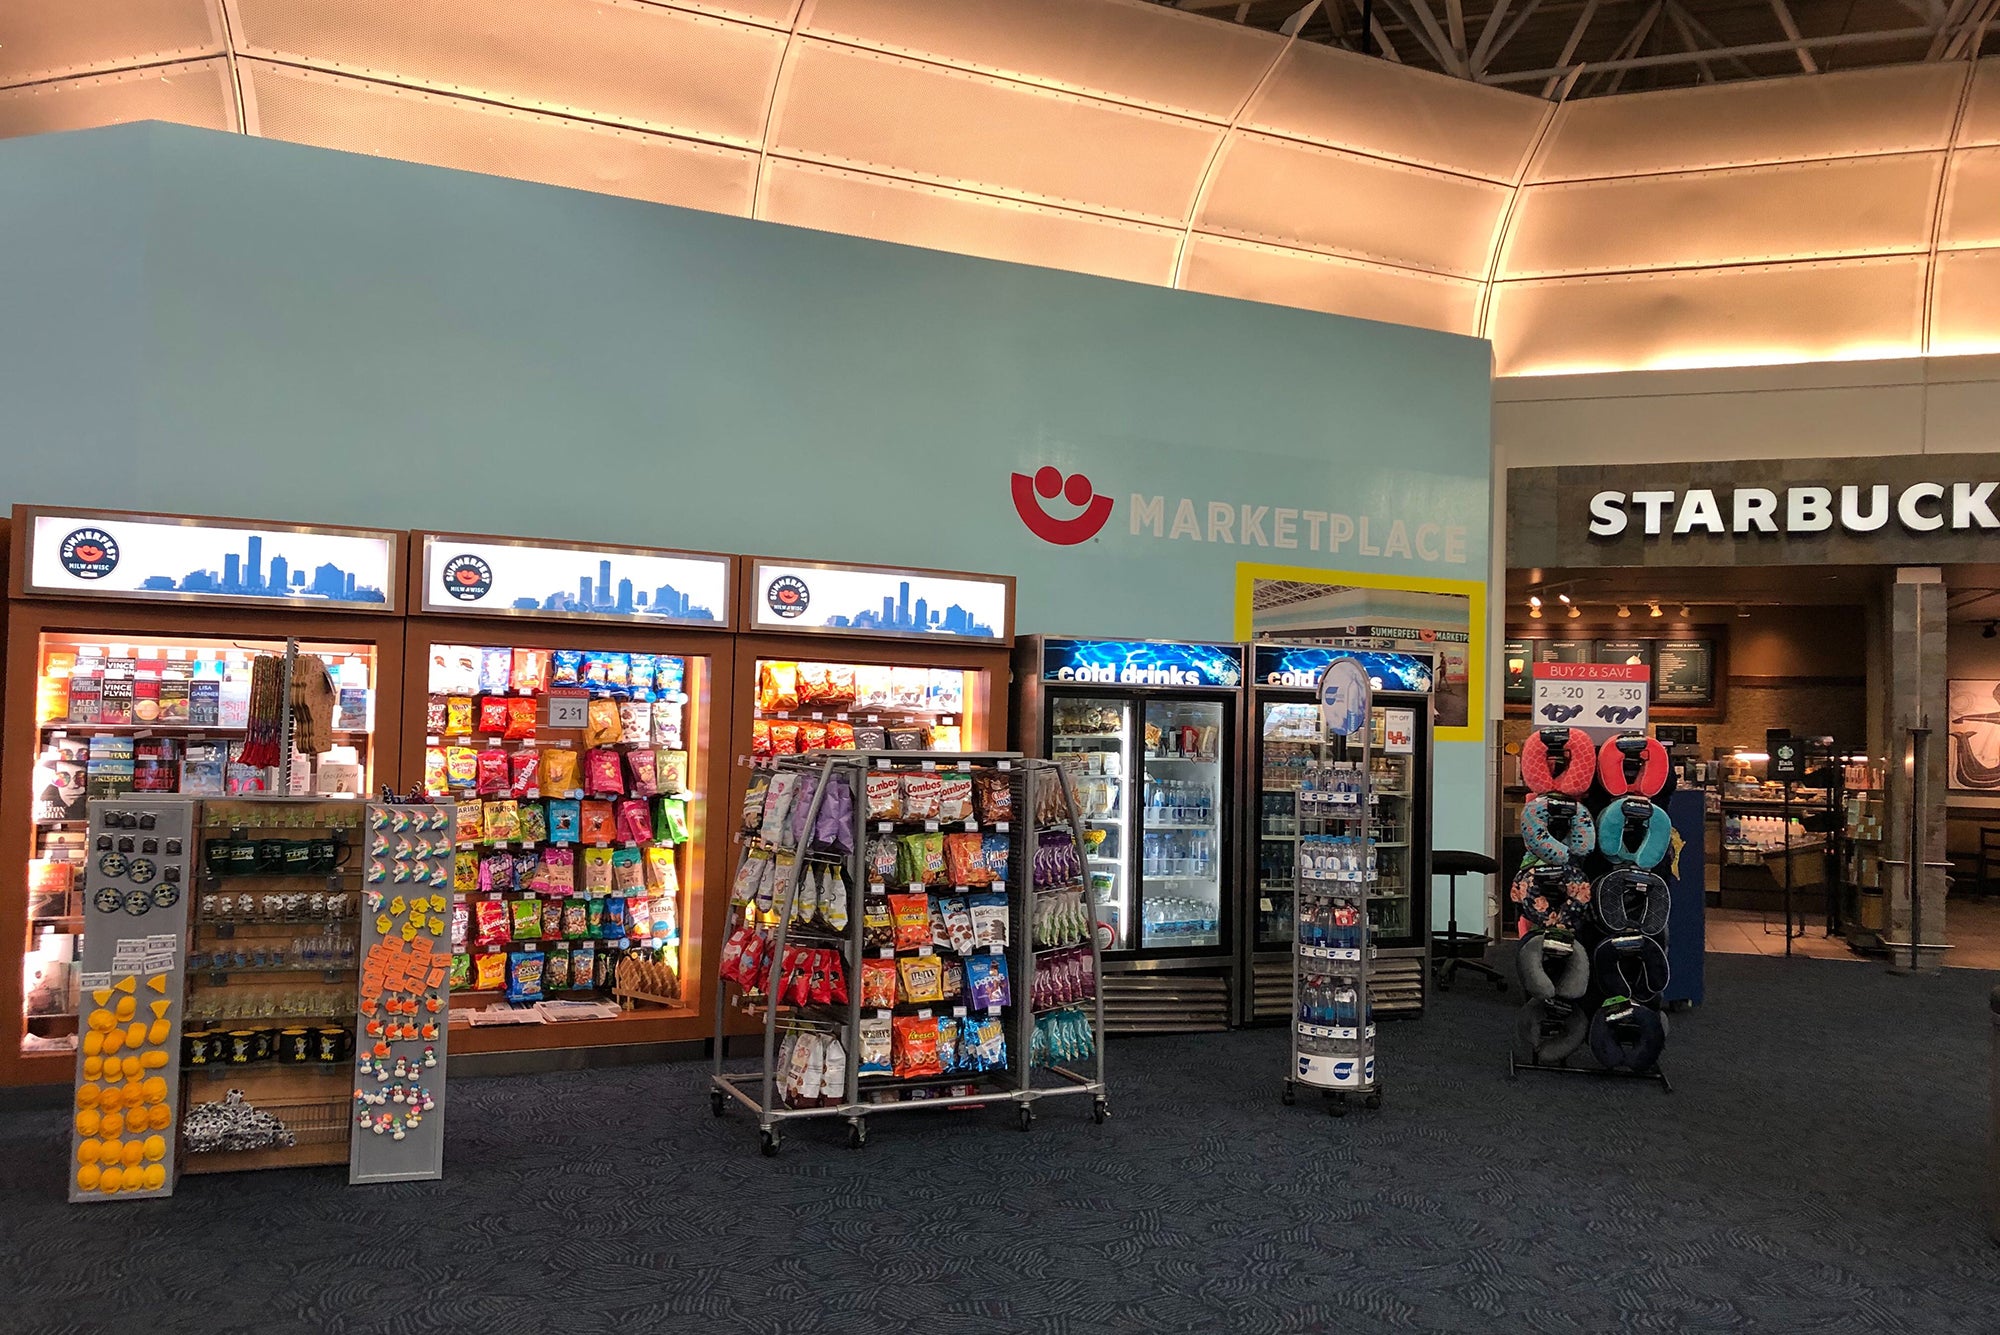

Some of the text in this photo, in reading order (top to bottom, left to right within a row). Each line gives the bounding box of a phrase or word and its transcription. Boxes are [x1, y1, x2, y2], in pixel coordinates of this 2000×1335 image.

[1129, 493, 1467, 564] MARKETPLACE
[63, 531, 117, 560] SUMMERFEST
[446, 557, 490, 584] SUMMERFEST
[770, 578, 808, 603] SUMMERFEST
[1371, 626, 1420, 639] SUMMERFEST
[1058, 662, 1200, 686] cold drinks
[1267, 669, 1315, 688] cold
[1550, 665, 1632, 679] BUY 2 & SAVE
[1540, 686, 1584, 699] 2 $20
[1597, 688, 1642, 701] 2 $30
[103, 701, 131, 710] RED
[195, 714, 214, 722] TELL
[559, 707, 582, 720] 2 $1
[866, 779, 898, 792] Combos
[907, 780, 942, 793] Combos
[457, 804, 480, 813] ARIBO
[489, 805, 516, 814] HARIBO
[649, 906, 673, 914] BIENA
